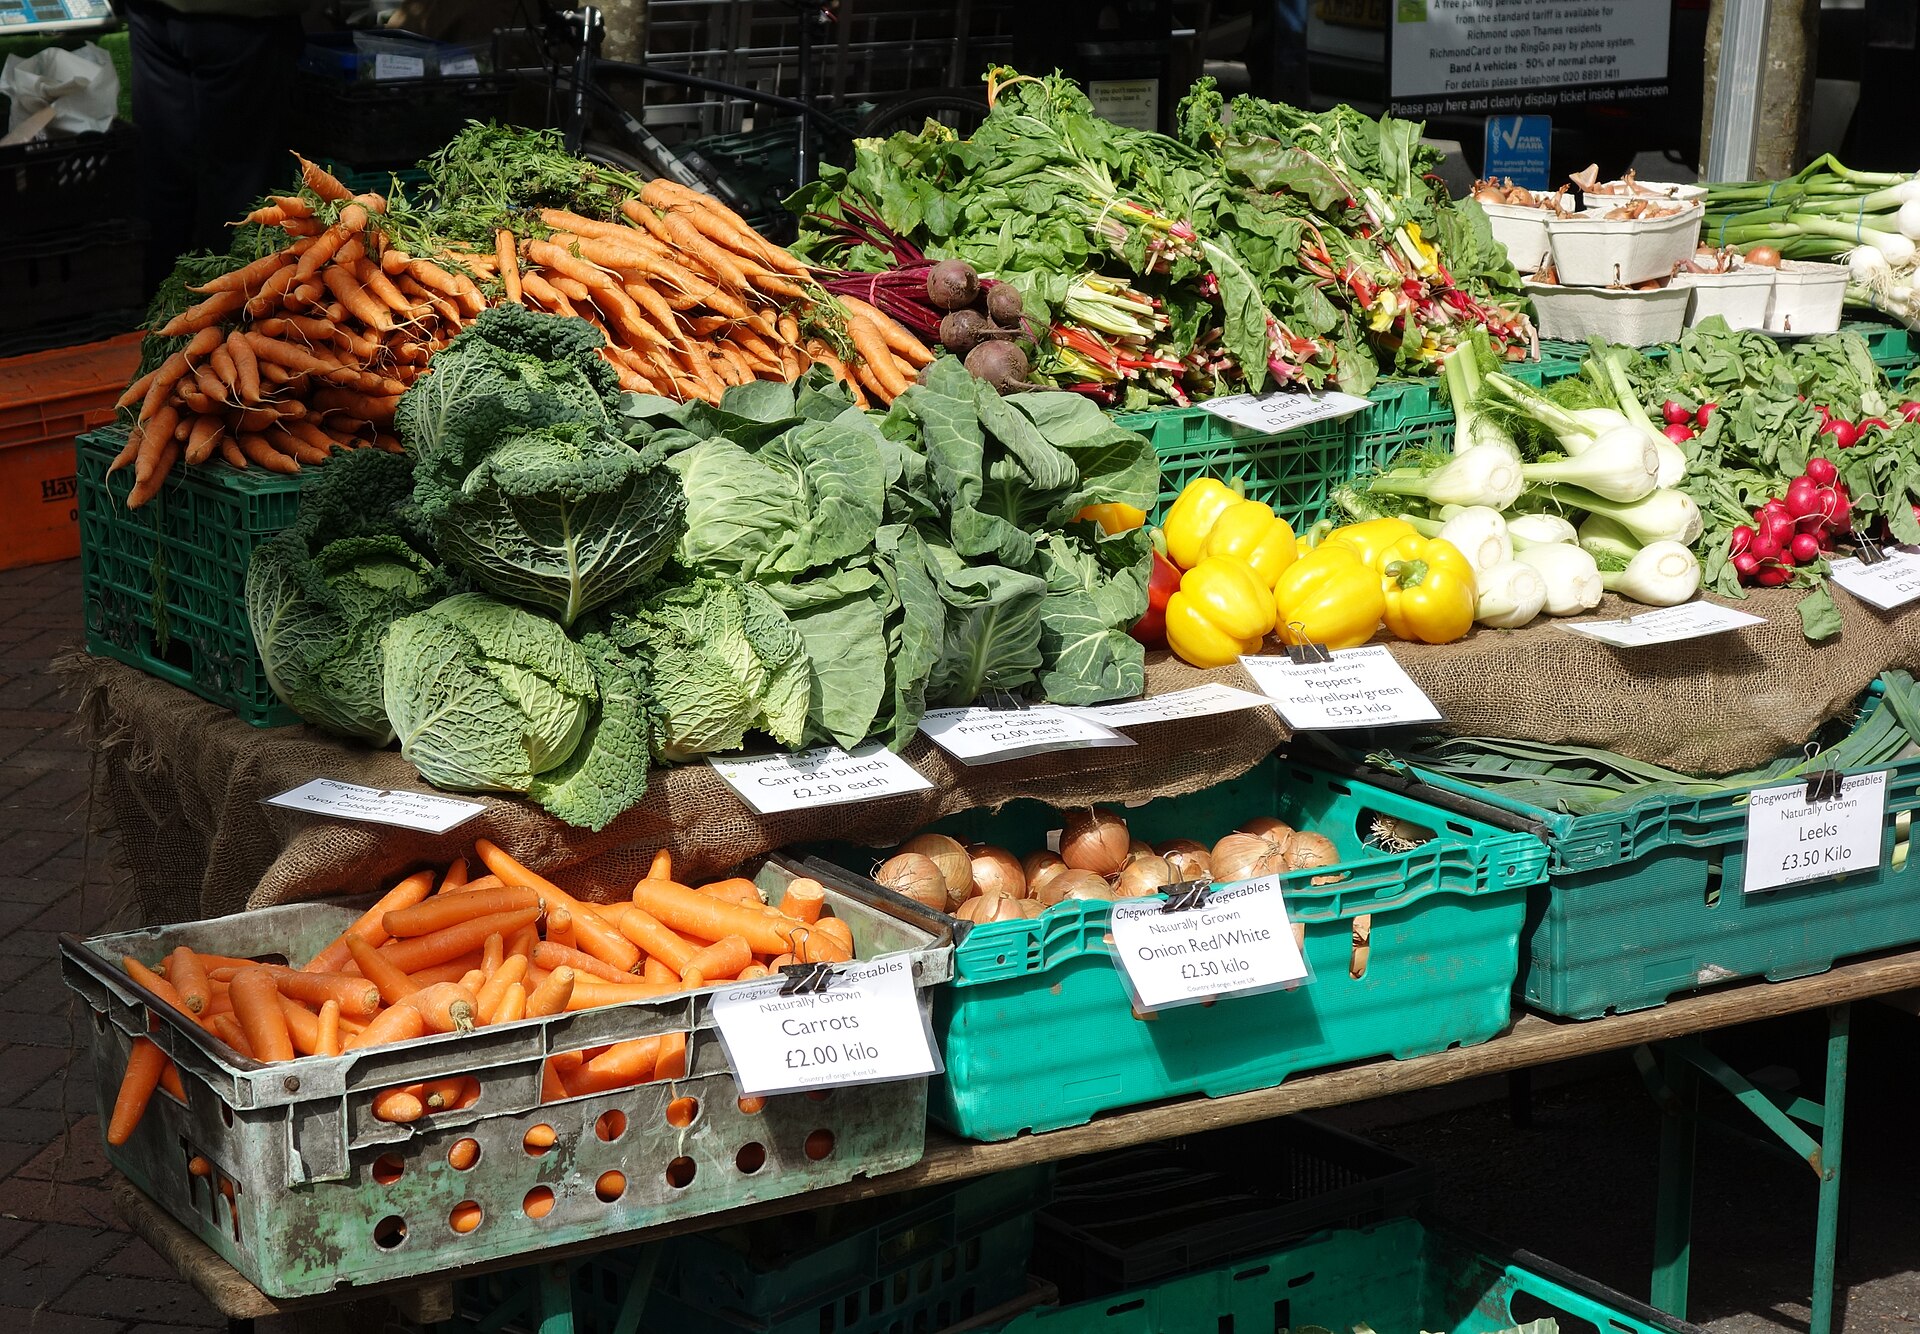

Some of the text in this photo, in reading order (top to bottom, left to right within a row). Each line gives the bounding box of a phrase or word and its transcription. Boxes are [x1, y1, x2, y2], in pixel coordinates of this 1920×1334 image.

[1435, 0, 1440, 8] A
[1443, 0, 1459, 9] free
[1462, 0, 1493, 10] parking
[1456, 7, 1614, 24] from the standard tariff is available for
[1467, 23, 1602, 40] Richmond upon Thames residents
[1429, 45, 1491, 59] RichmondCard
[1493, 46, 1502, 55] or
[1504, 44, 1518, 54] the
[1520, 41, 1551, 54] RingGo
[1552, 43, 1567, 53] pay
[1569, 41, 1578, 51] by
[1580, 39, 1604, 50] phone
[1449, 63, 1471, 74] Band
[1474, 62, 1481, 72] A
[1483, 60, 1517, 71] vehicles
[1525, 58, 1544, 69] 50%
[1547, 57, 1555, 67] of
[1557, 56, 1586, 67] normal
[1588, 54, 1616, 66] charge
[1445, 68, 1620, 90] For details please telephone 020 8891 1411
[1390, 85, 1669, 116] Please pay here and clearly display ticket inside windscreen
[1261, 397, 1302, 413] Chard
[1267, 412, 1301, 426] £2.50
[1296, 402, 1338, 416] bunch
[1879, 568, 1917, 581] Radish
[1641, 618, 1695, 631] Fennel
[1692, 619, 1728, 629] each
[1281, 663, 1365, 677] Naturally Grown
[1305, 676, 1362, 690] Peppers
[1289, 687, 1404, 705] red/yellow/green
[956, 713, 1003, 723] Naturally
[1100, 703, 1173, 717] Beetroot
[1326, 703, 1391, 717] £5.95 kilo
[957, 717, 1065, 735] Primo Cabbage
[991, 726, 1065, 741] £2.00 each
[763, 760, 815, 772] Naturally
[816, 754, 857, 765] Grown
[757, 760, 889, 787] Carrots bunch
[321, 780, 379, 795] Chegworth
[415, 794, 471, 807] Vegetables
[792, 776, 889, 799] £2.50 each
[1750, 774, 1883, 807] Chegworth egetables
[303, 794, 336, 805] Savoy
[337, 800, 381, 812] Cabbage
[383, 806, 415, 816] £1.70
[415, 813, 441, 821] each
[340, 792, 389, 804] Naturally
[392, 799, 429, 809] Grown
[1781, 798, 1858, 820] Naturally Grown
[1799, 822, 1838, 841] Leeks
[1781, 845, 1852, 871] £3.50 Kilo
[1149, 911, 1242, 935] Naturally Grown
[1138, 927, 1271, 961] Onion Red/White
[1181, 957, 1250, 979] £2.50 kilo
[1187, 984, 1209, 992] Country
[759, 990, 862, 1014] Naturally Grown
[781, 1014, 859, 1037] Carrots
[785, 1041, 879, 1069] £2.00 kilo
